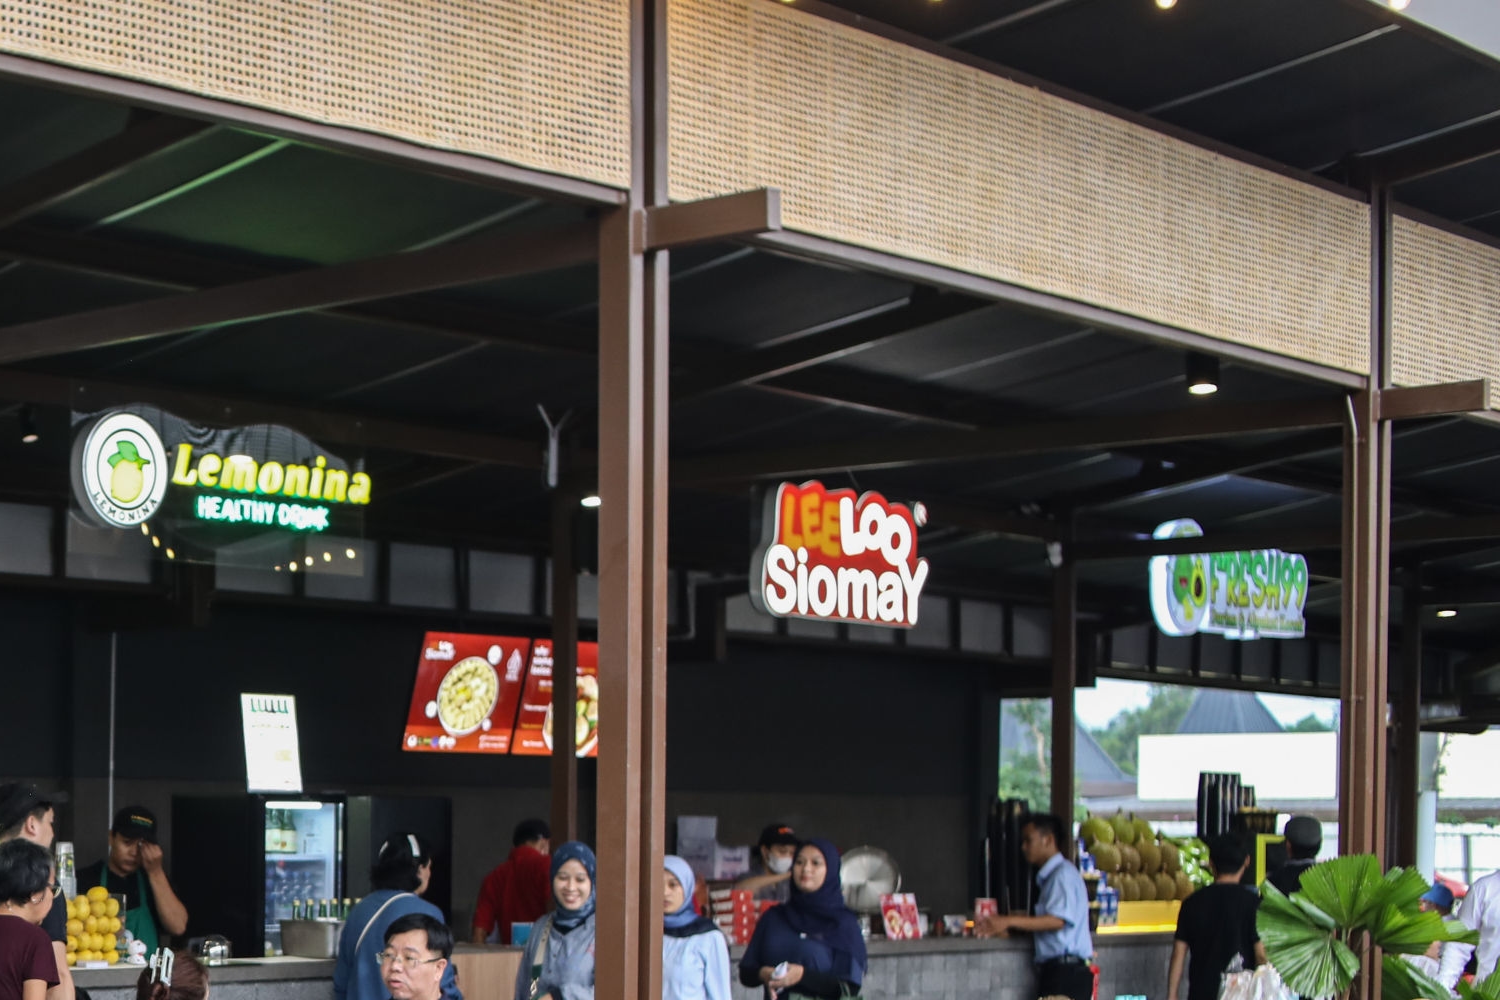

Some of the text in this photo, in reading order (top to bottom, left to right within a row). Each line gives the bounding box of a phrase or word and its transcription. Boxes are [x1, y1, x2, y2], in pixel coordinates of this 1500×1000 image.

[171, 443, 372, 505] Lemonina
[93, 491, 158, 521] LEMONINA
[197, 495, 276, 525] HEALTHY
